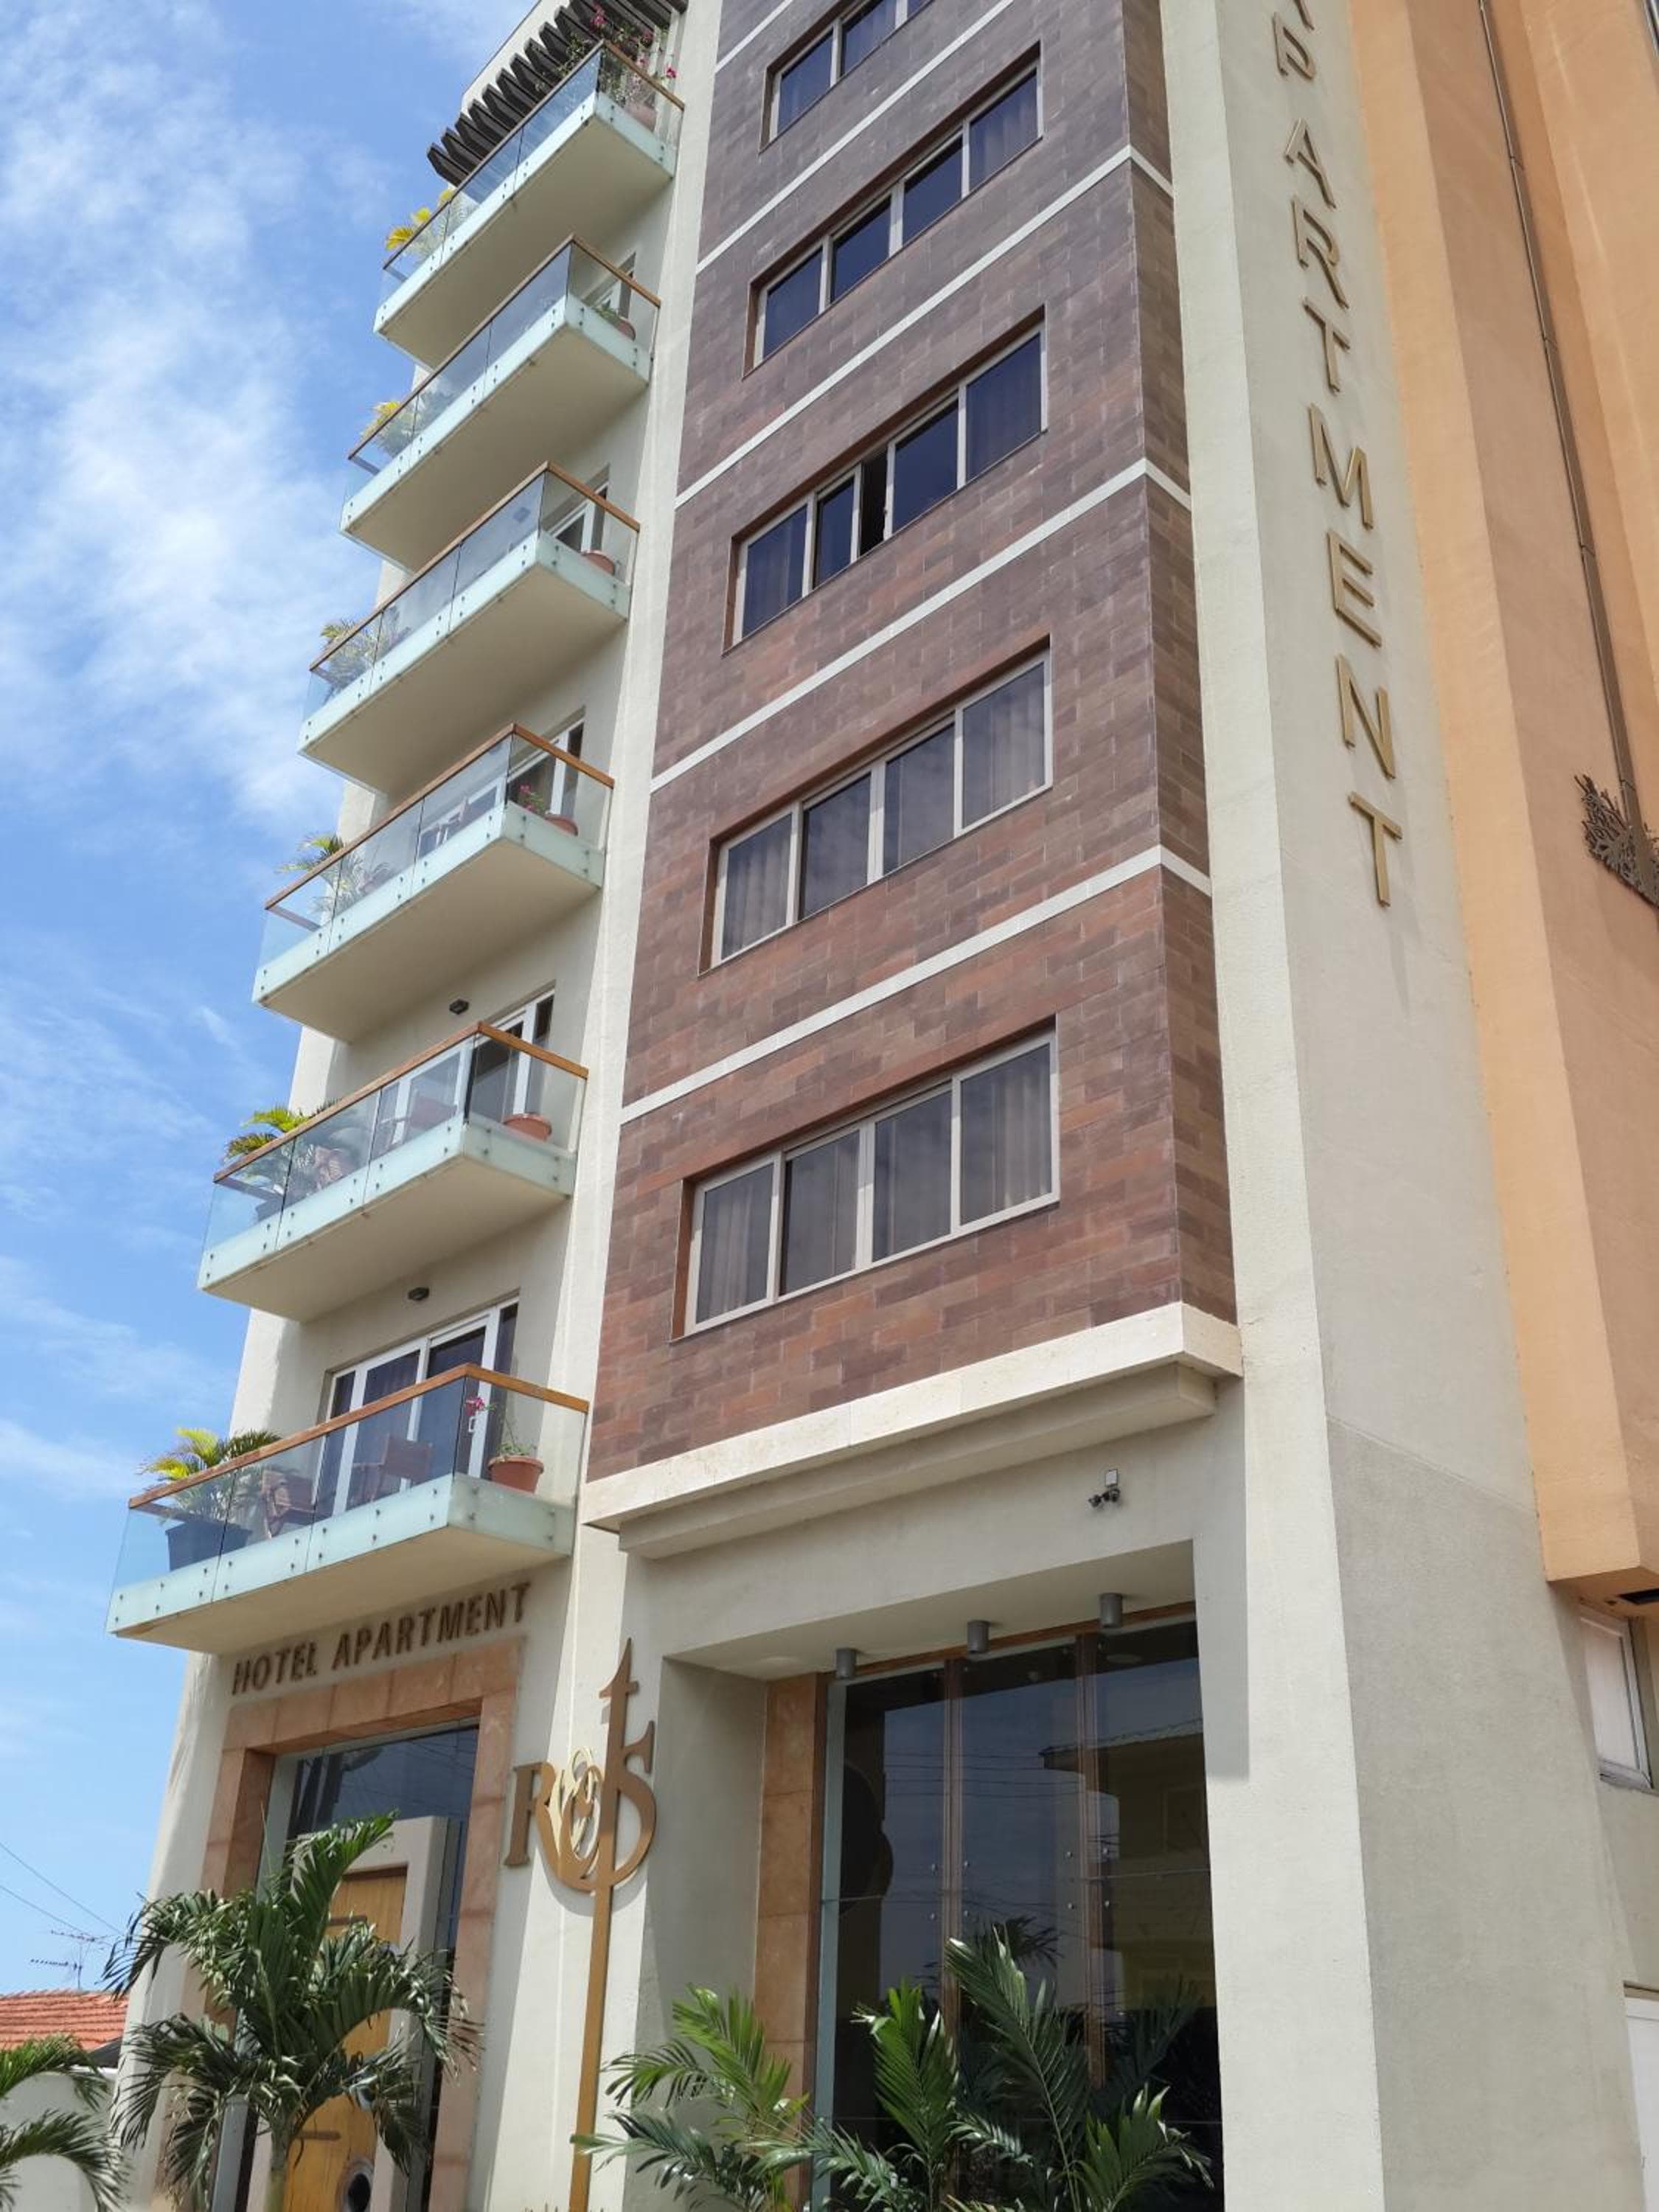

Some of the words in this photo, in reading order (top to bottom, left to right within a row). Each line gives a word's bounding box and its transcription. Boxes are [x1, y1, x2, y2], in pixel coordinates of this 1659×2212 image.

[1272, 0, 1402, 907] PARTMENT
[232, 1641, 318, 1695] HOTEL
[330, 1581, 532, 1670] APARTMENT
